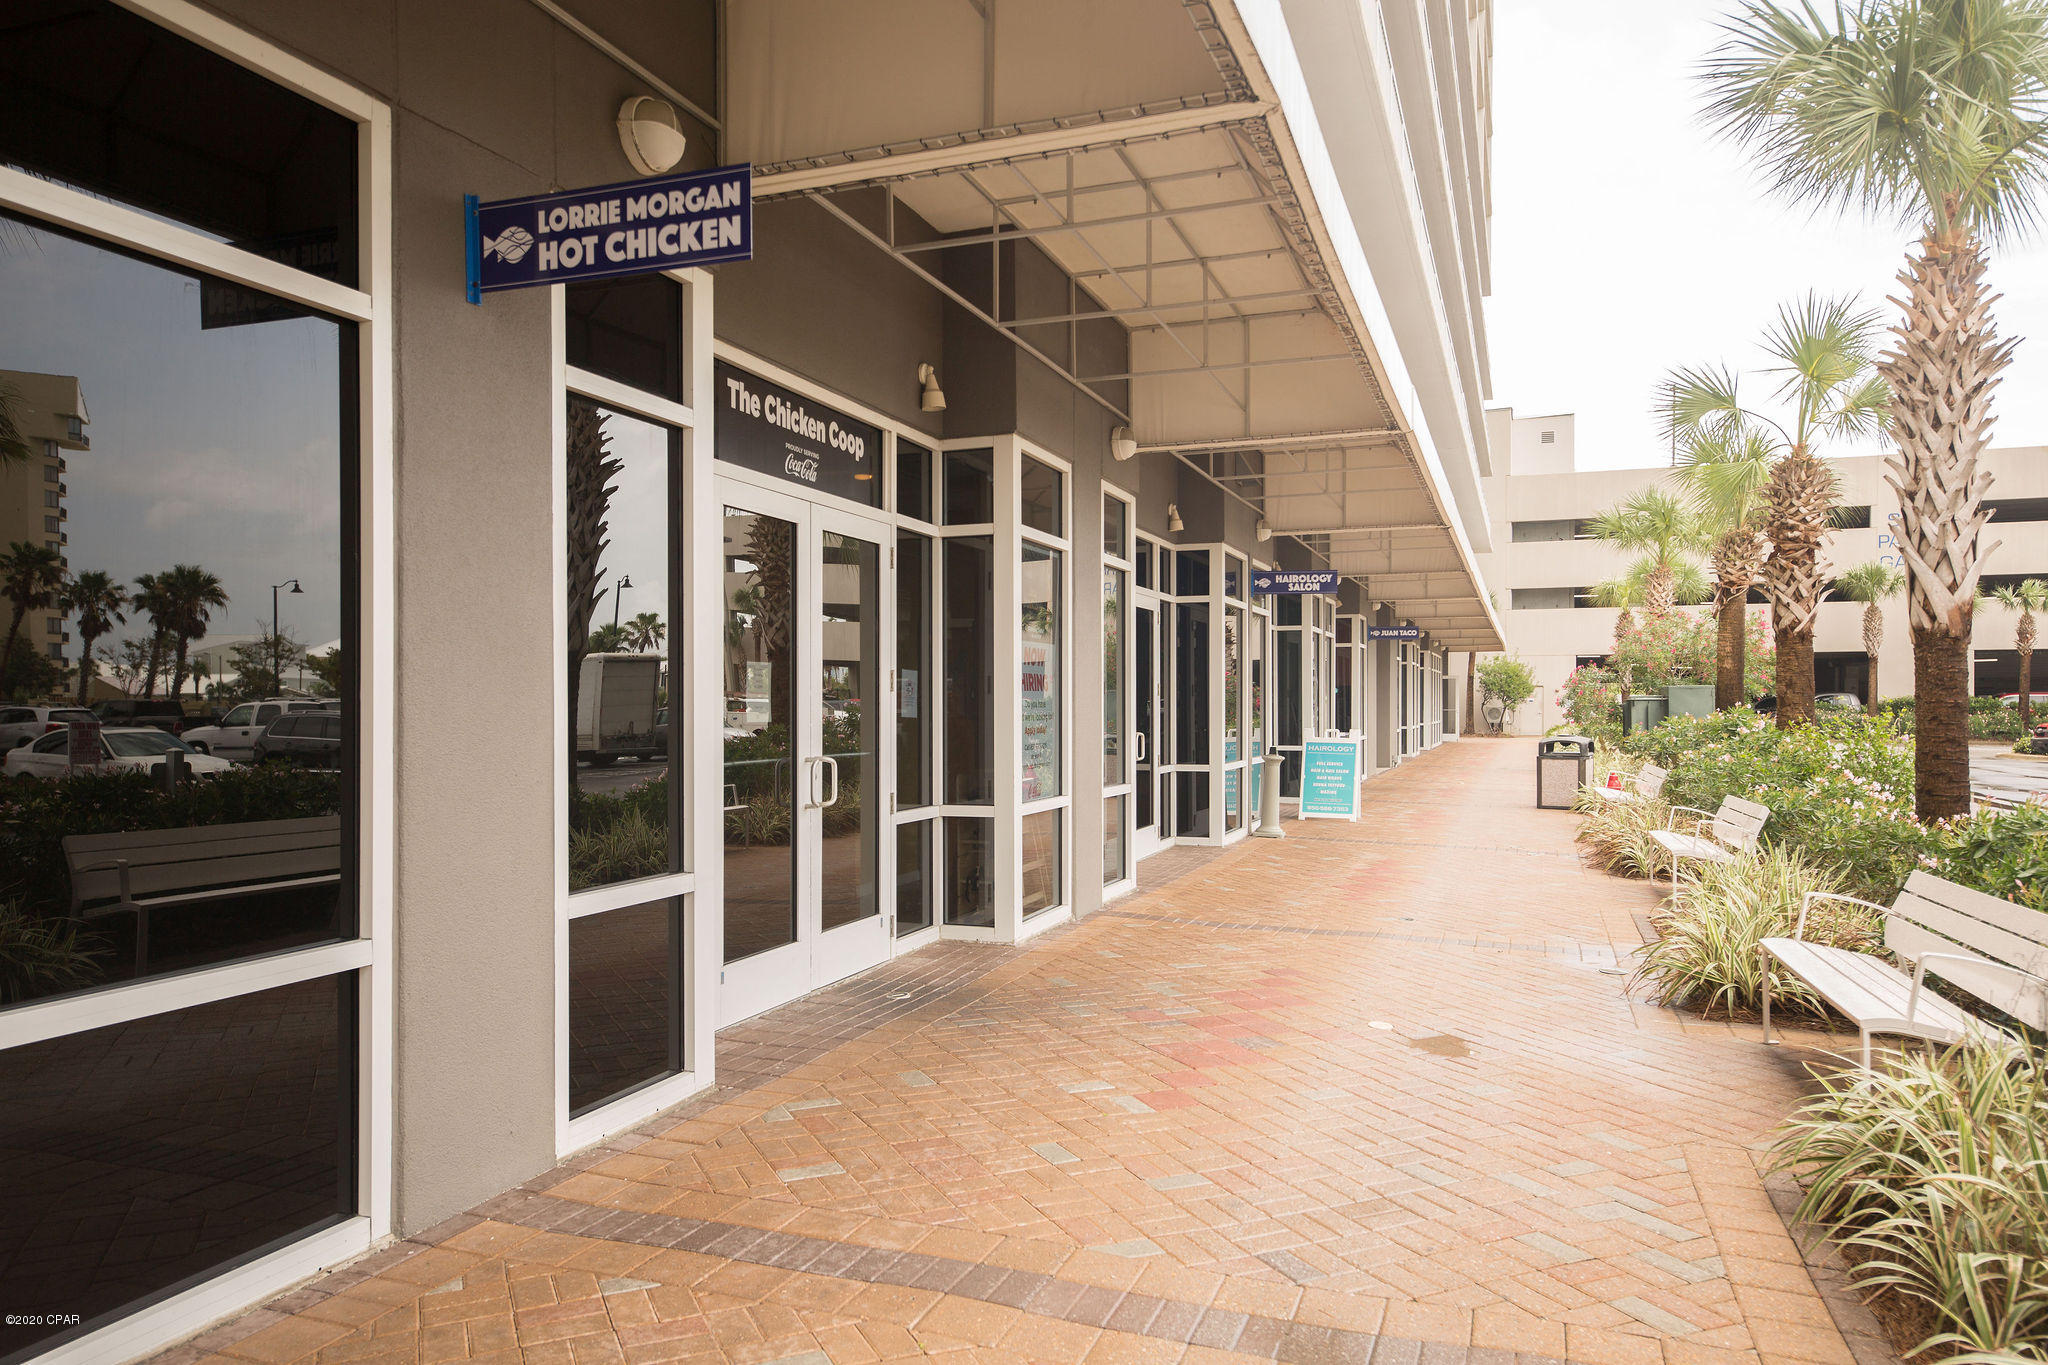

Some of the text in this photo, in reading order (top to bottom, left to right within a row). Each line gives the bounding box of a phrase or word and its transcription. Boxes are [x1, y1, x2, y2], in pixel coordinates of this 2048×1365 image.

[537, 181, 741, 234] LORRIE MORGAN
[538, 214, 742, 272] HOT CHICKEN
[727, 377, 865, 462] The Chicken Coop
[785, 442, 820, 460] PROUDLY SERVING
[1275, 574, 1333, 584] HAIROLOGY
[1288, 582, 1321, 591] SALON
[1399, 629, 1418, 637] TACO
[1023, 646, 1046, 667] NOW
